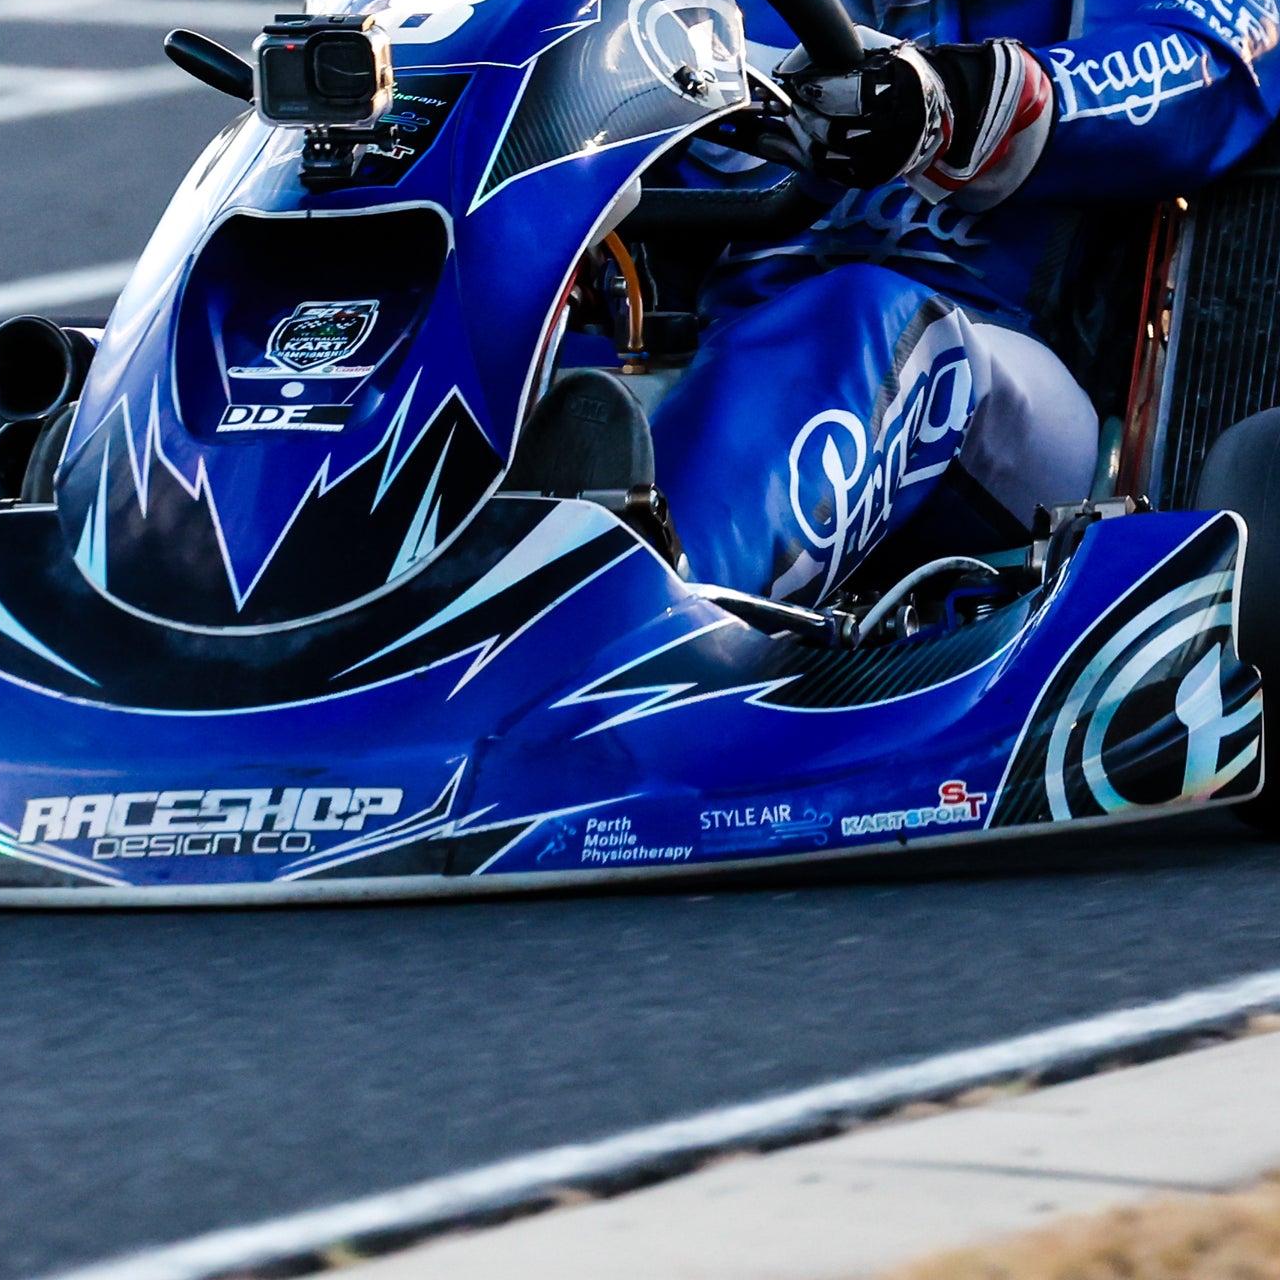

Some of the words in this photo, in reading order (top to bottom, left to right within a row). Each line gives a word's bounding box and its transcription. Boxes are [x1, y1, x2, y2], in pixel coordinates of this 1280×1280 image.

[1048, 33, 1204, 126] Praga
[283, 341, 349, 352] KART
[19, 787, 404, 845] RACESHOP
[586, 816, 631, 833] Perth
[700, 807, 757, 830] STYLE
[760, 804, 791, 825] AIR
[251, 831, 317, 854] CO.
[584, 831, 637, 847] Mobile
[581, 845, 693, 864] Physiotherapy
